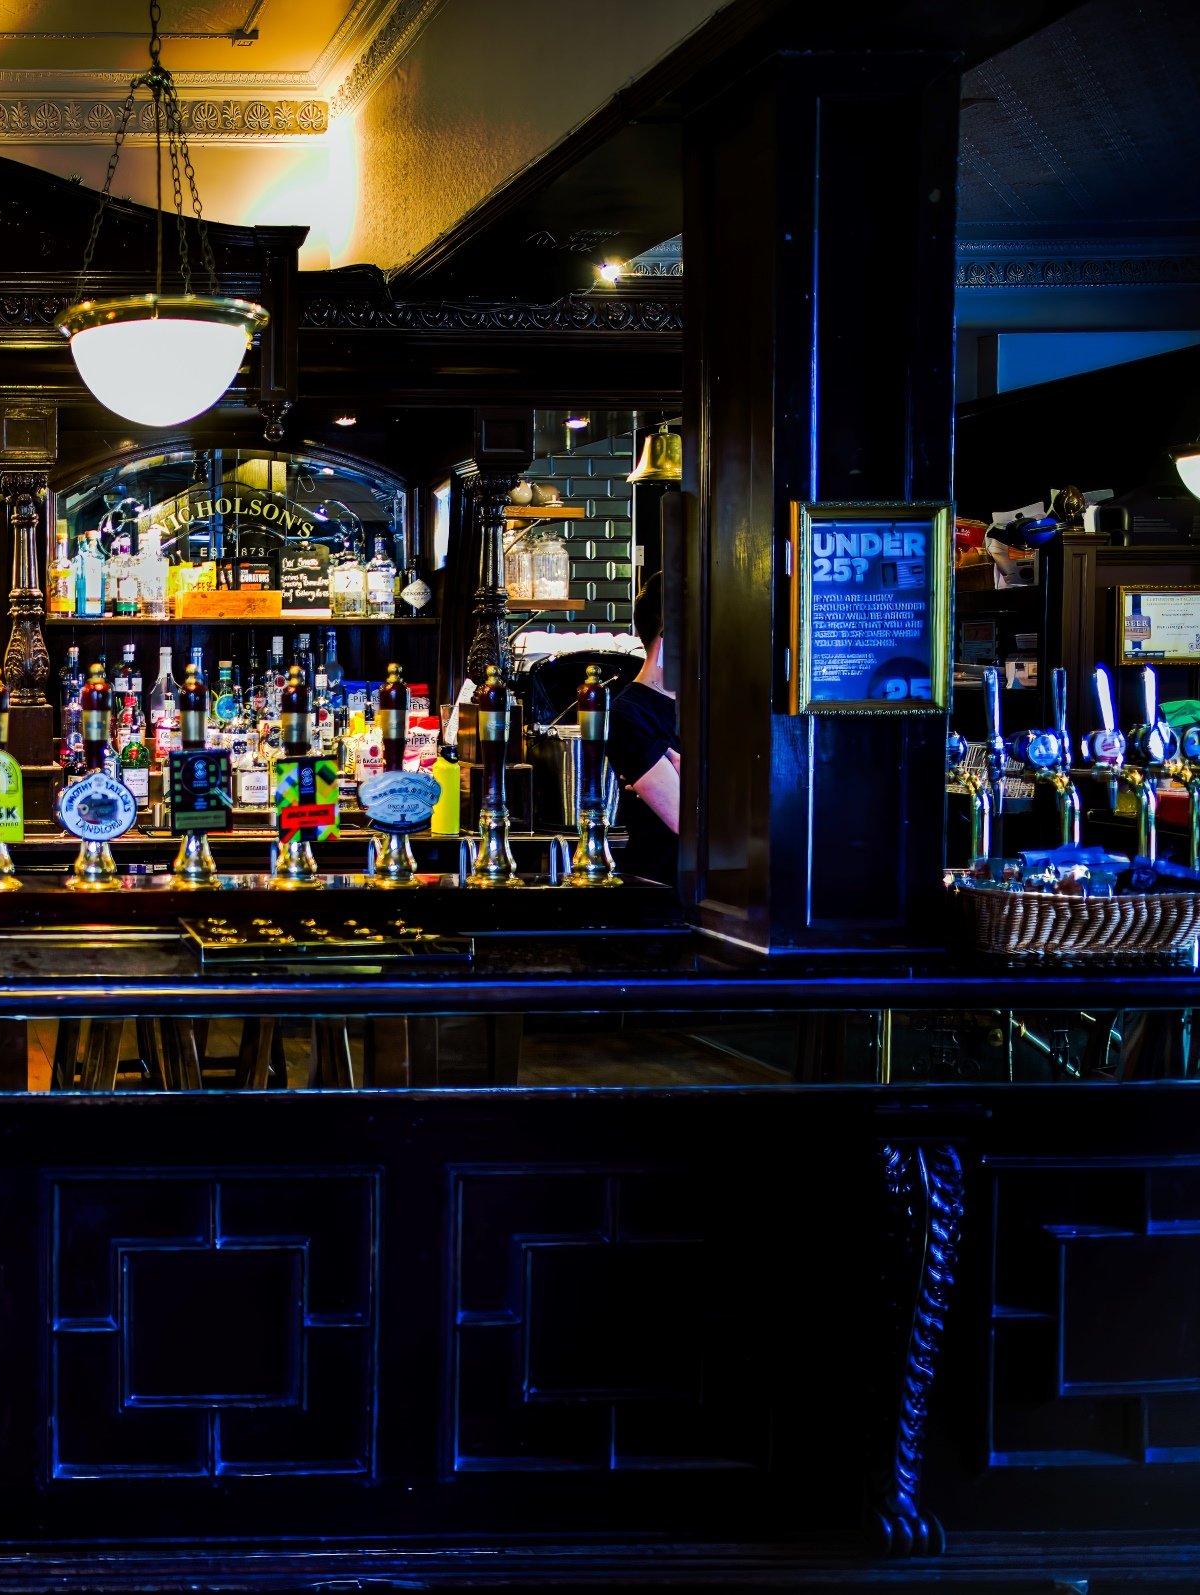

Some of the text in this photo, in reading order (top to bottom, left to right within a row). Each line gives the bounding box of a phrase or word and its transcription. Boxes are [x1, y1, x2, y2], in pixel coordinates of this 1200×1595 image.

[812, 533, 926, 557] UNDER
[200, 547, 265, 557] EST 1873
[813, 557, 869, 582] 25?
[353, 695, 380, 703] PIPRS
[406, 737, 436, 745] PIPERS
[75, 818, 123, 834] LANDLORD
